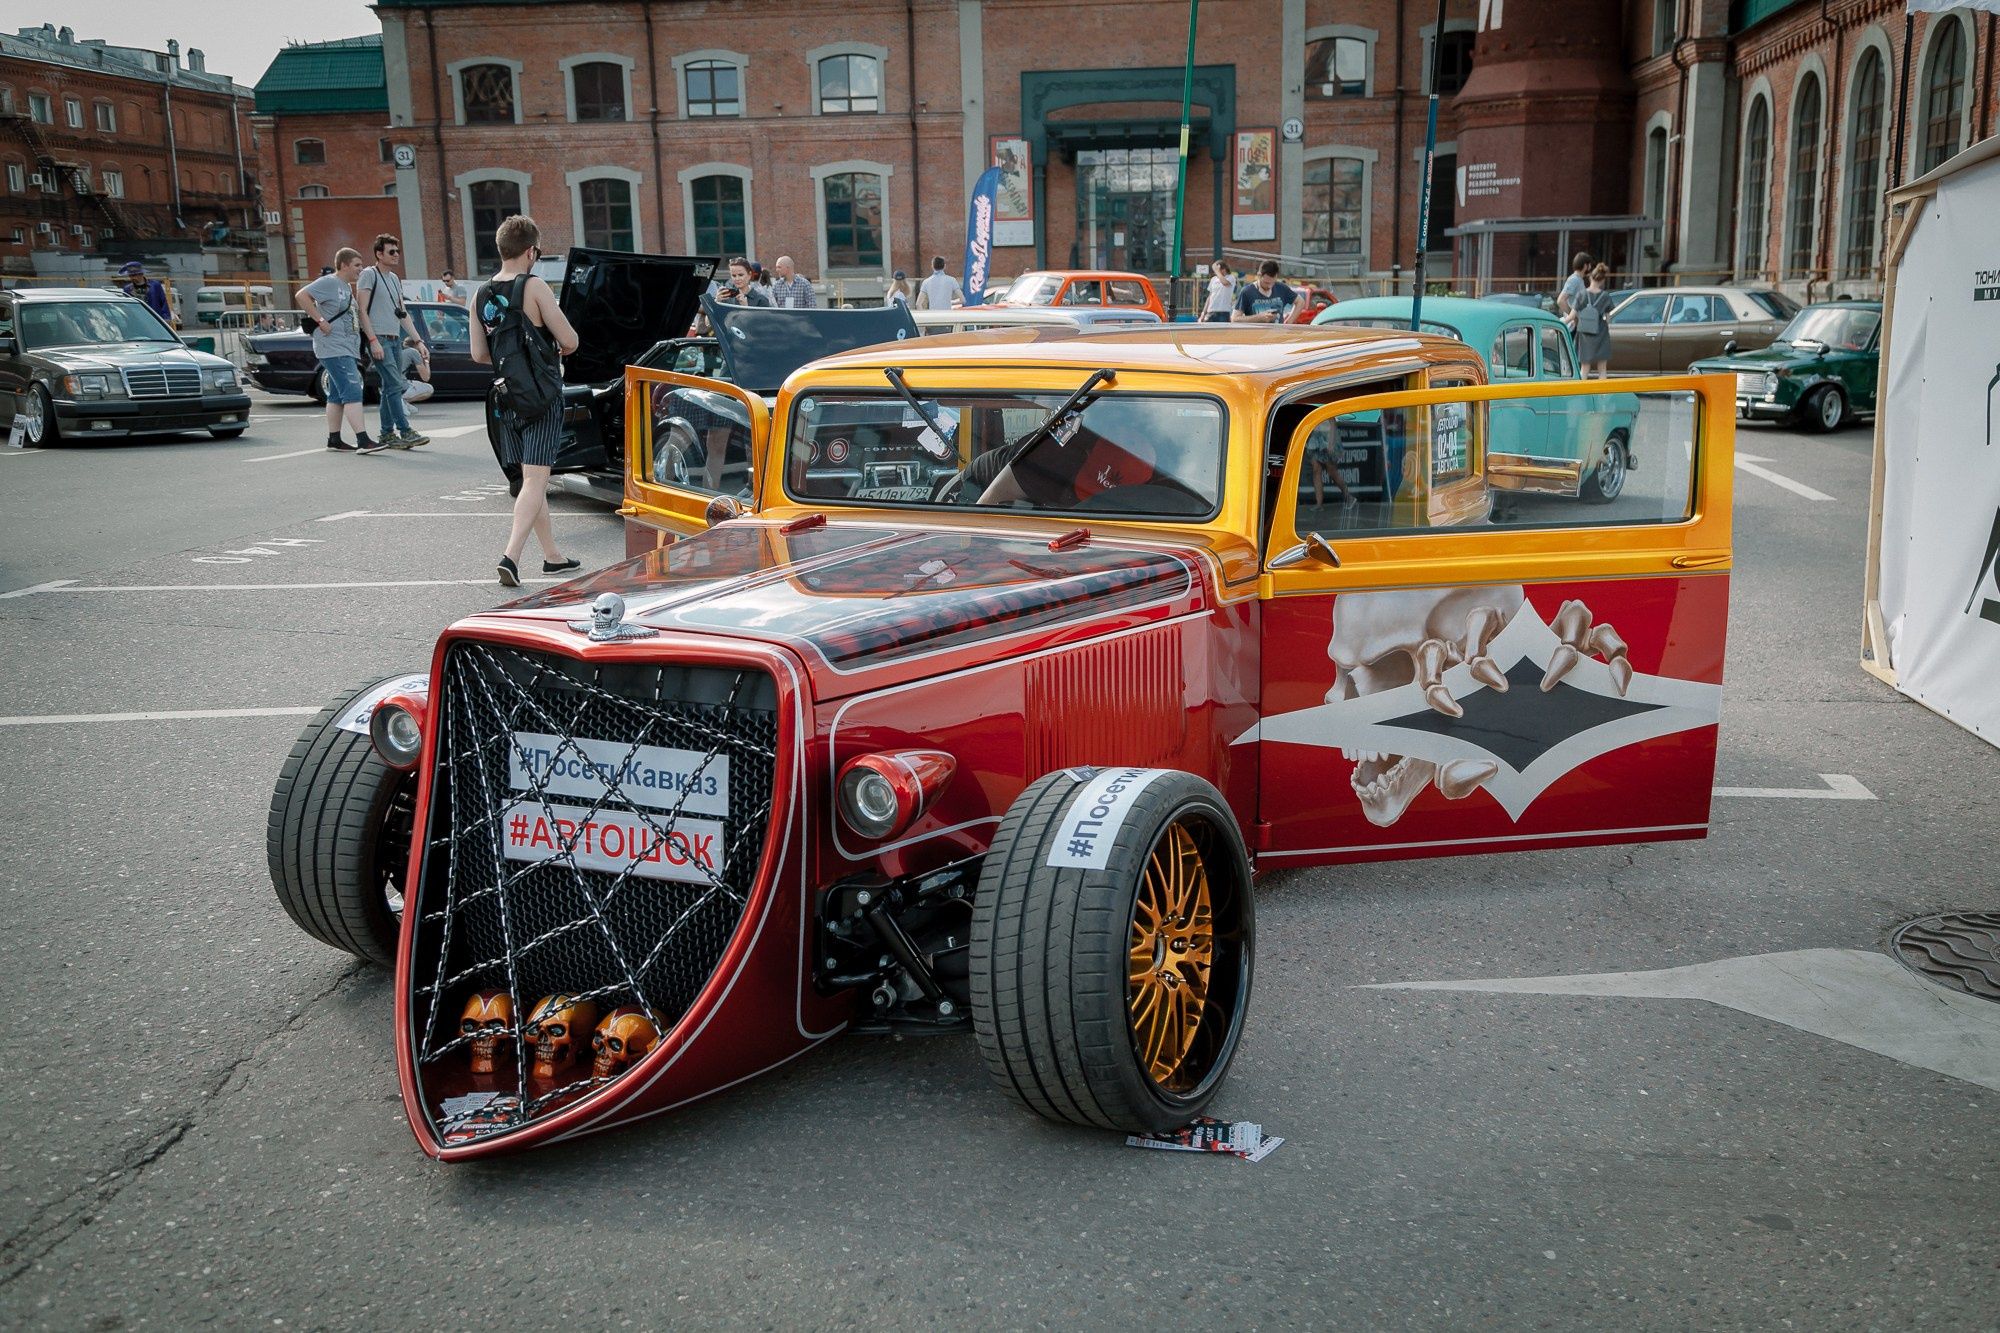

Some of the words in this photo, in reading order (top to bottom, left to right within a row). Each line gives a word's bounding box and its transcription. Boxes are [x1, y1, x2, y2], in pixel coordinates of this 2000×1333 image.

[1286, 124, 1299, 133] 31
[398, 151, 411, 161] 31
[909, 487, 929, 497] 799
[519, 746, 718, 796] #ПосетиКавказ
[509, 813, 714, 868] #АВТОШОК
